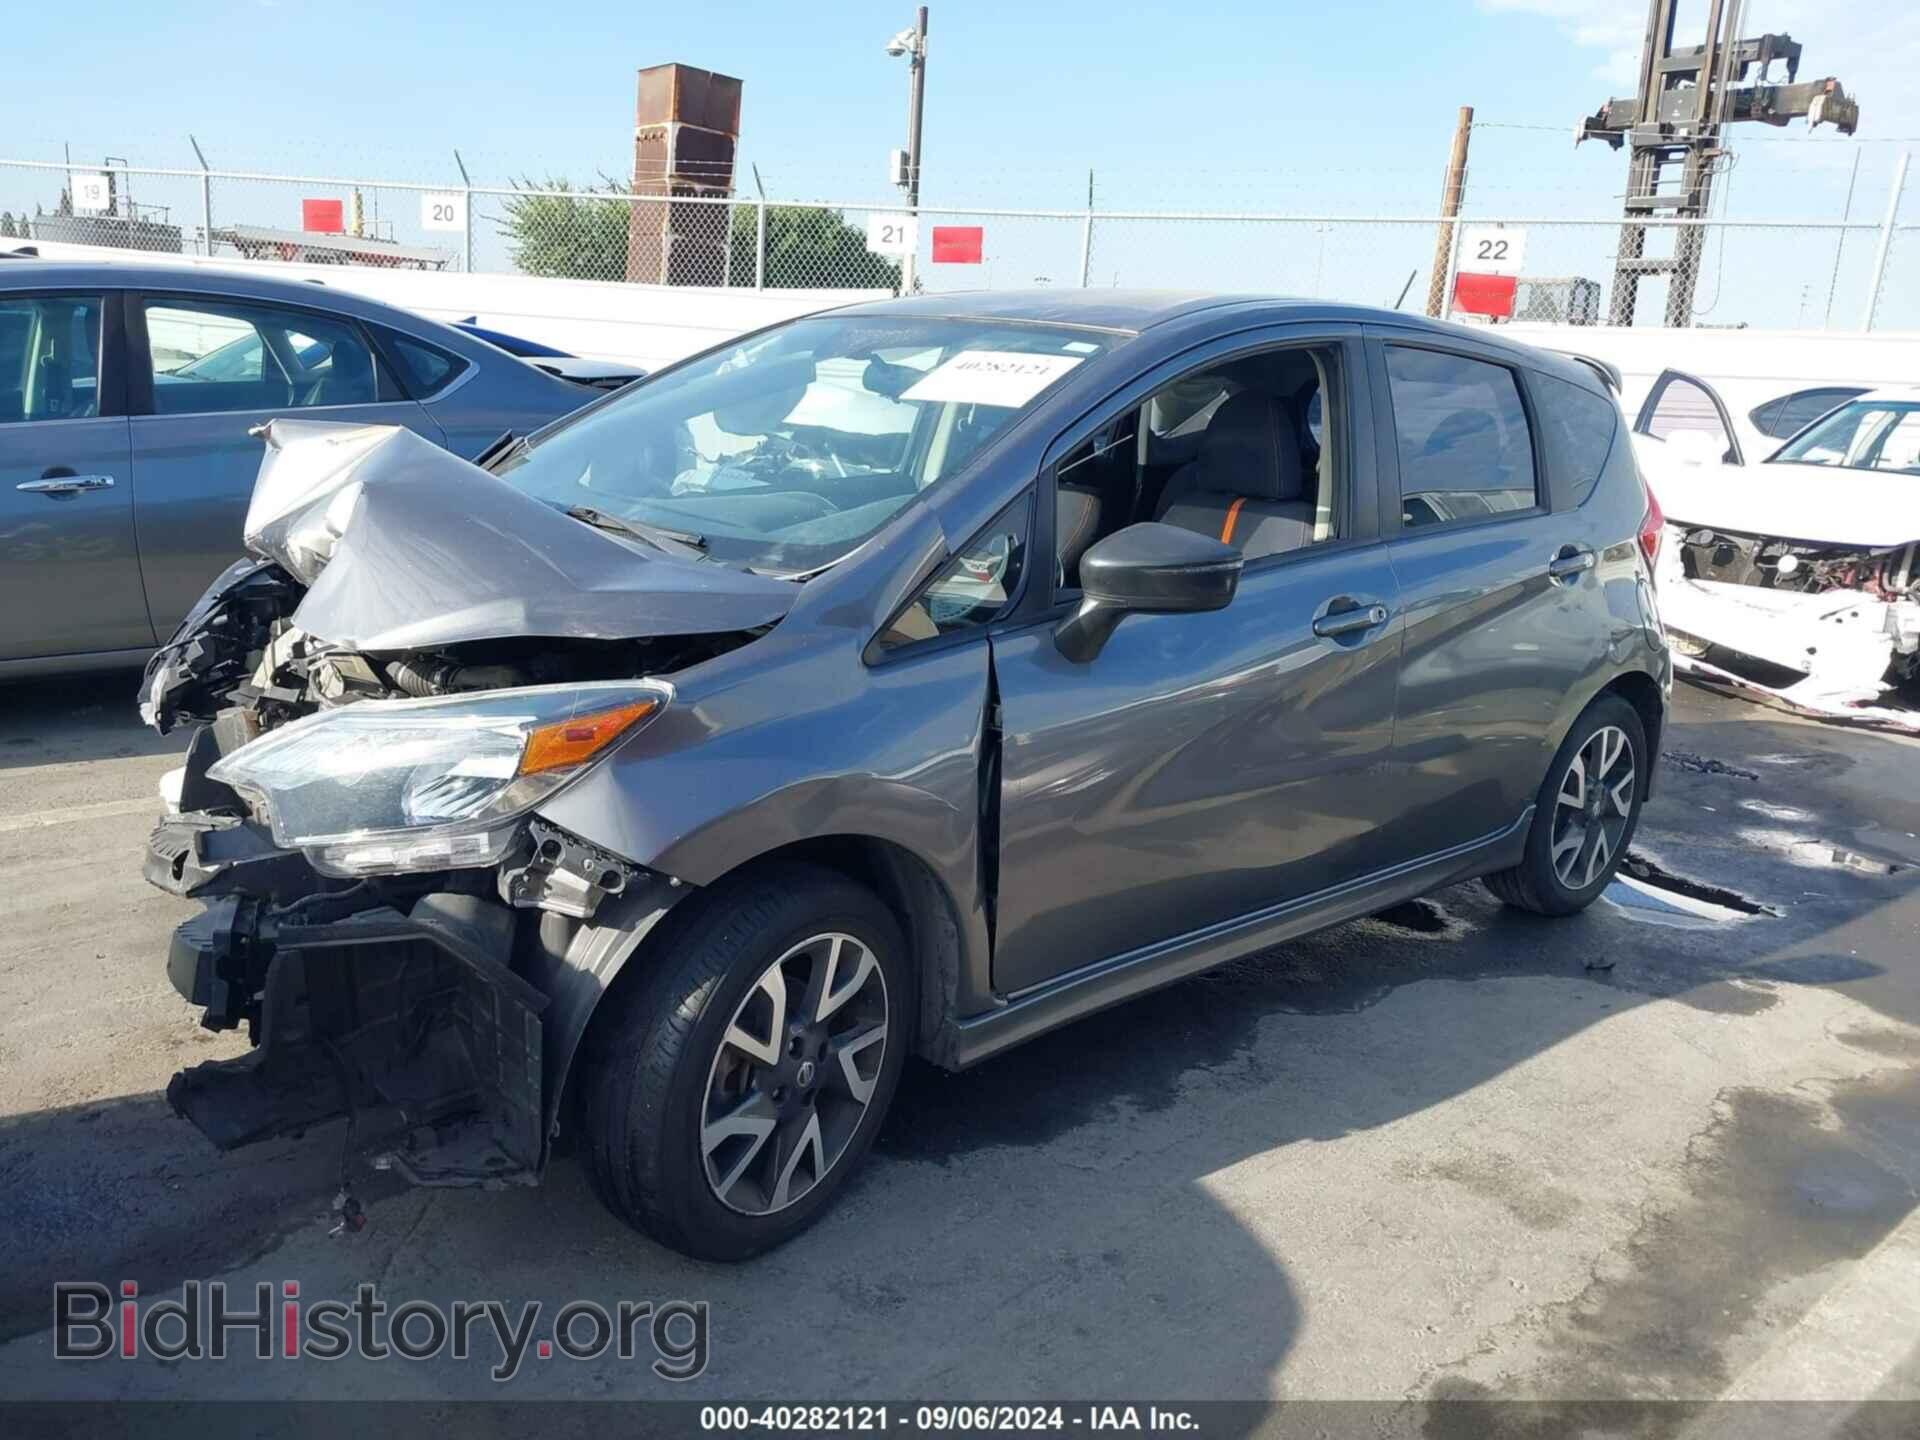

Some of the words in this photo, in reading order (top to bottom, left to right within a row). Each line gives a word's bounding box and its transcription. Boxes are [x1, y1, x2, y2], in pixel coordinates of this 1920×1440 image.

[84, 184, 100, 200] 19
[432, 204, 455, 222] 20
[881, 224, 904, 244] 21
[1477, 239, 1509, 260] 22
